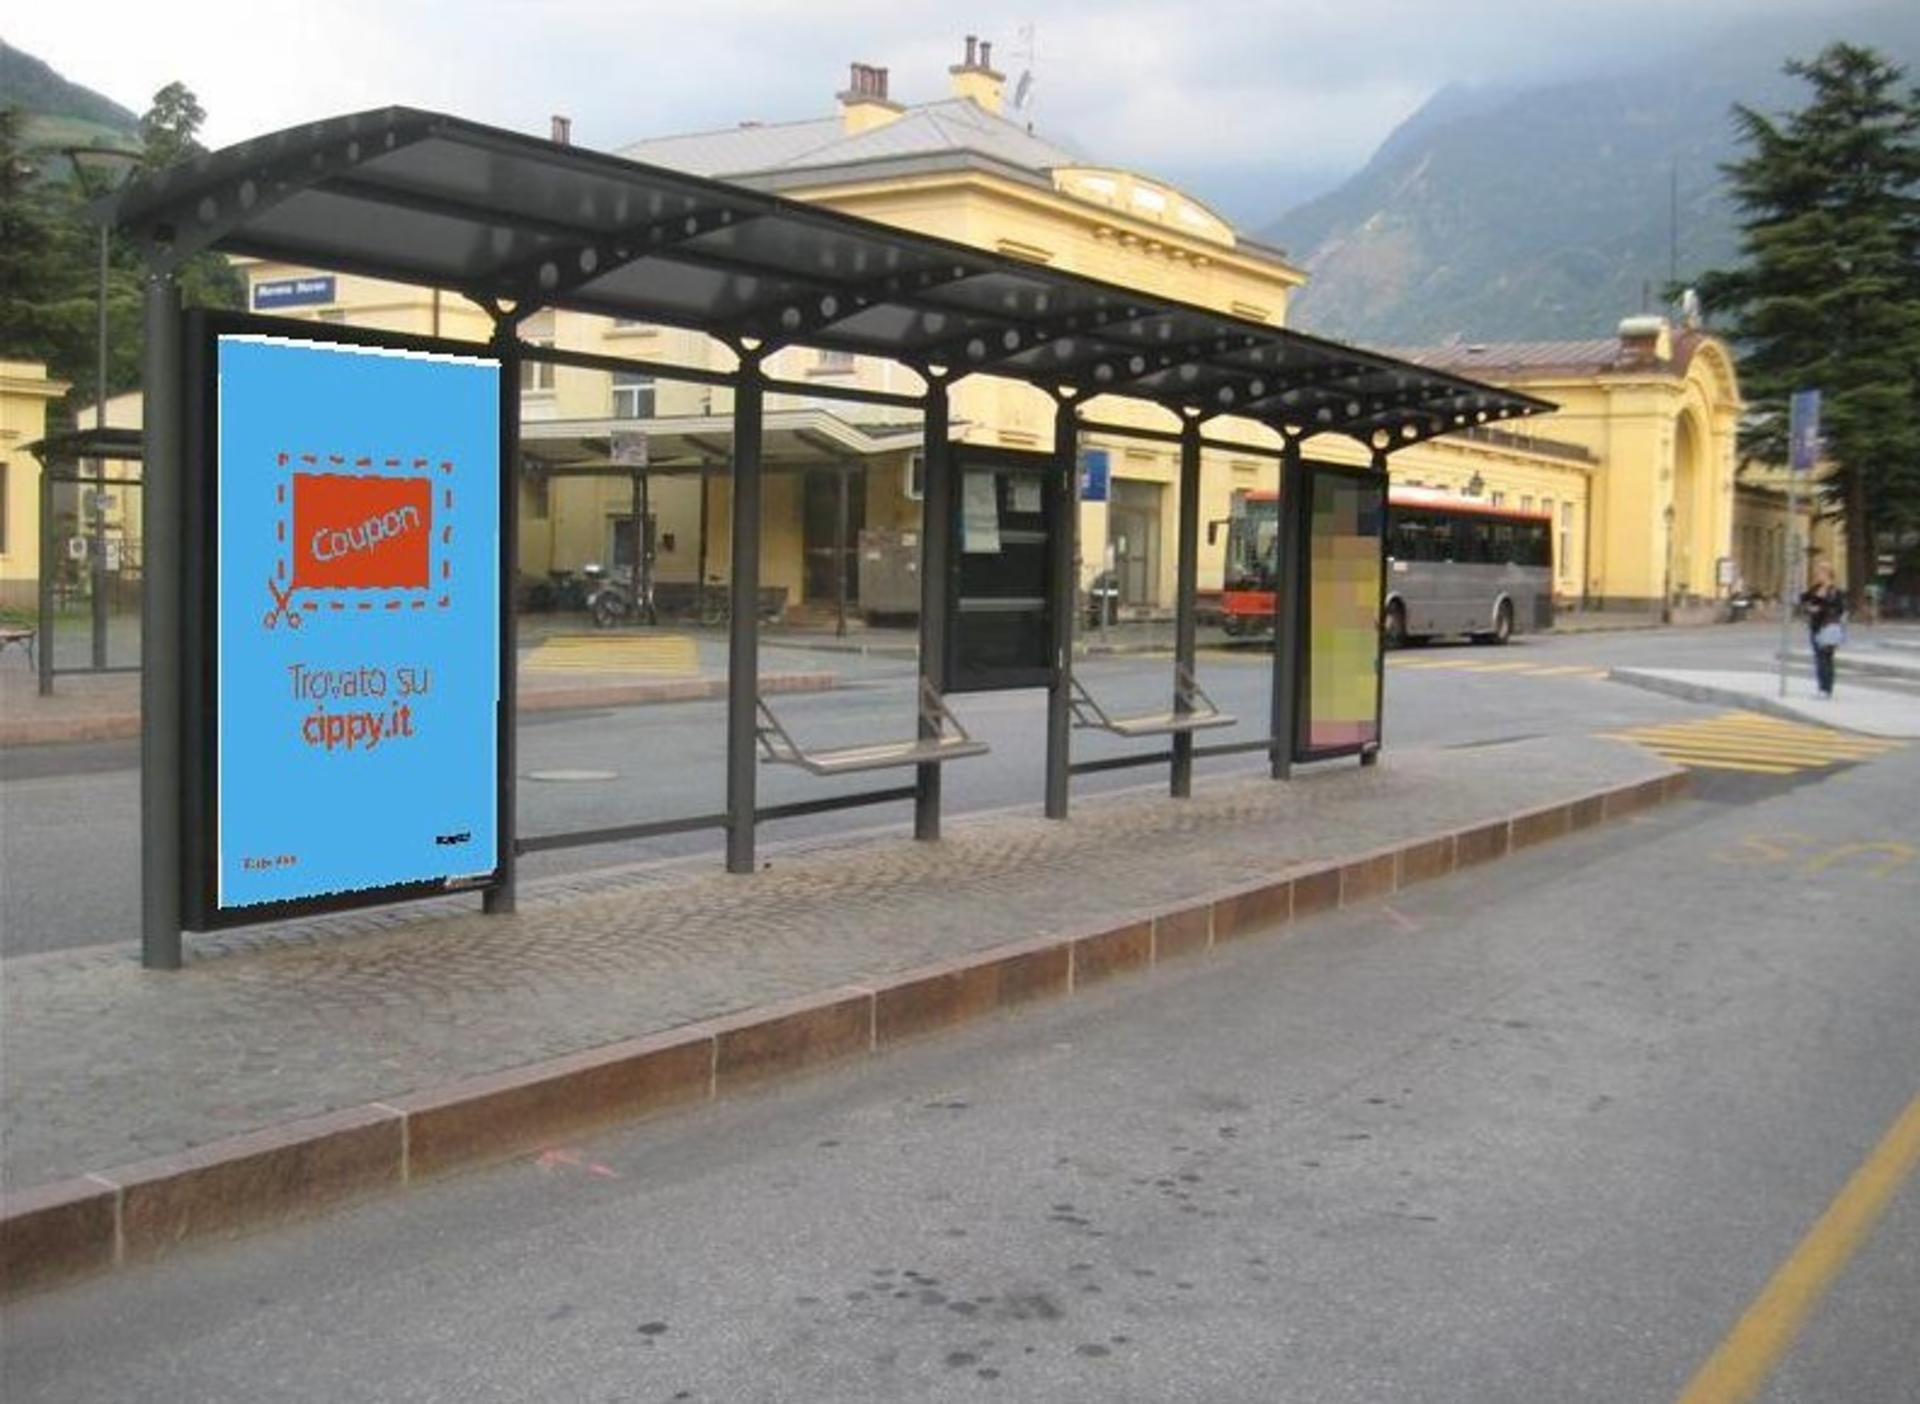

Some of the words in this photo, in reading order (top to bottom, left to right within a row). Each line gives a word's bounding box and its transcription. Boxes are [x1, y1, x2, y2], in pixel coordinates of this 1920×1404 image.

[310, 505, 420, 561] Coupon
[287, 663, 386, 700] Trovato
[396, 666, 428, 695] su
[302, 700, 412, 751] cippy.it
